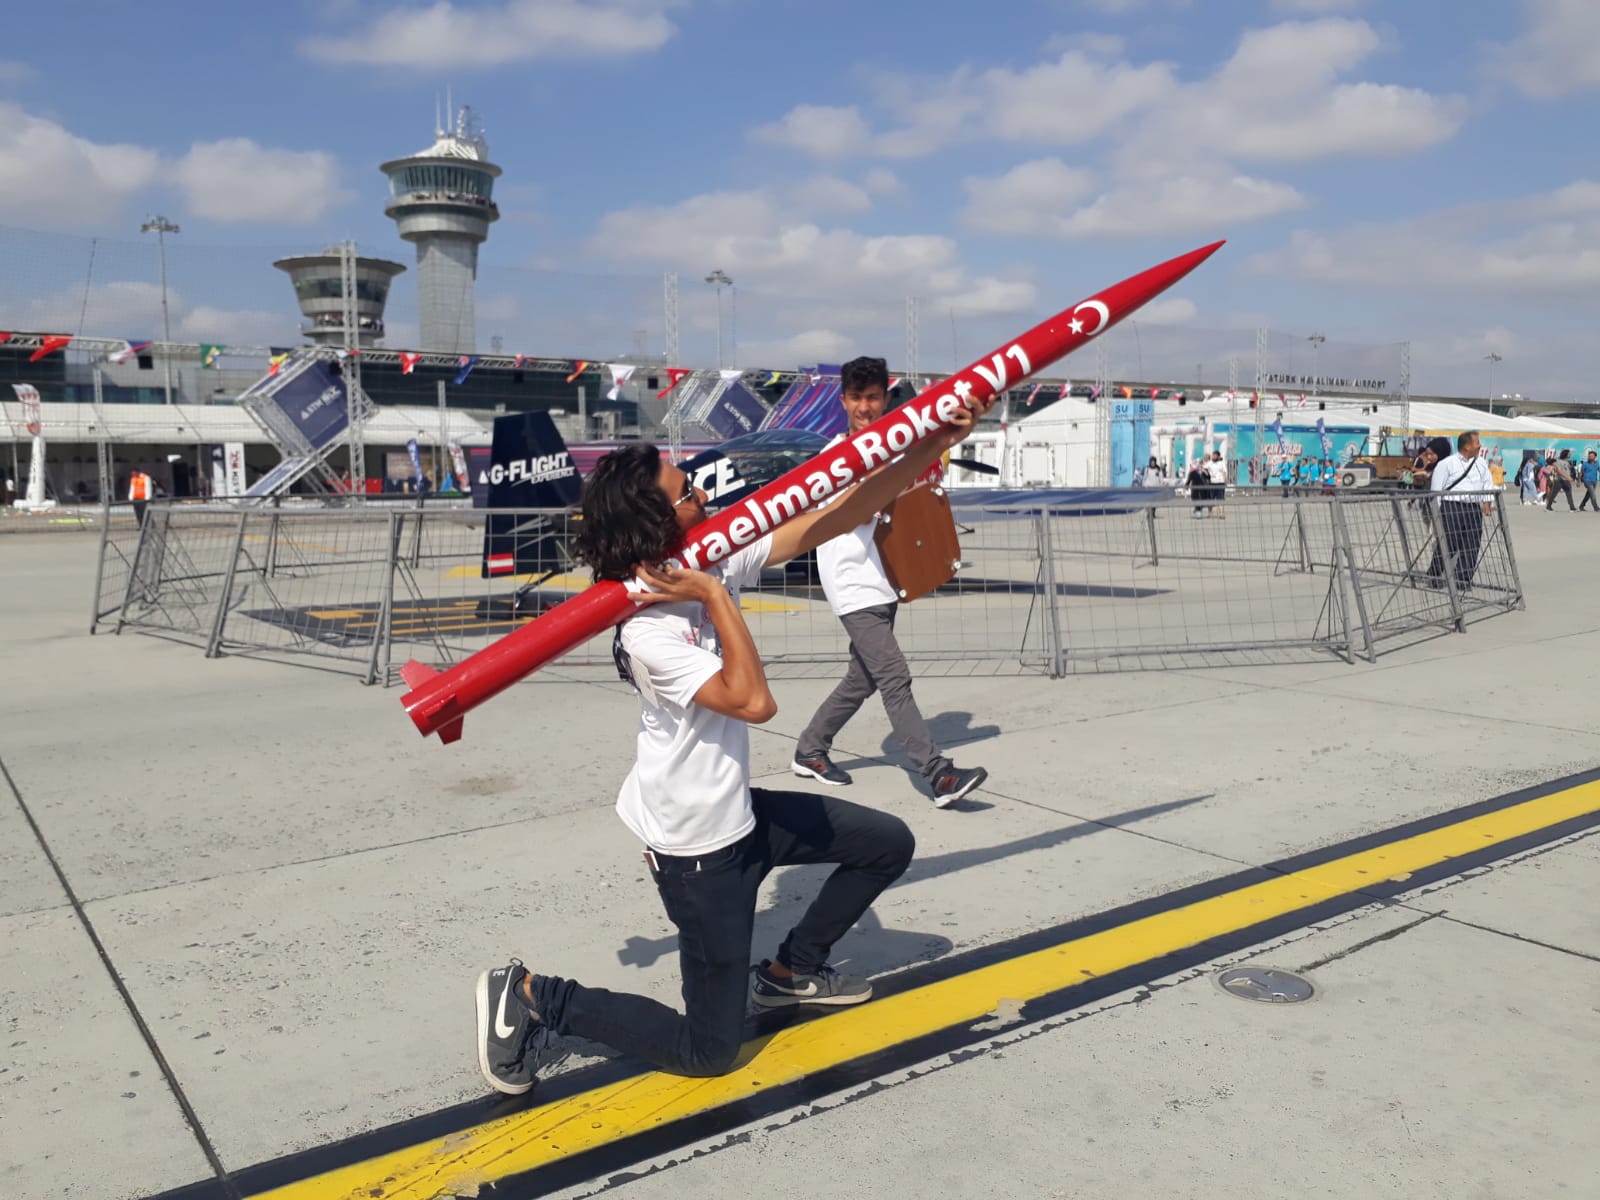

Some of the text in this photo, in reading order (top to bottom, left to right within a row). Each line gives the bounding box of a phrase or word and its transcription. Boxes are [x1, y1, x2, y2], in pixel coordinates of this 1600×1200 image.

[852, 380, 974, 470] Roket
[972, 344, 1031, 392] V1
[1115, 404, 1128, 413] SU
[1139, 403, 1150, 413] SU
